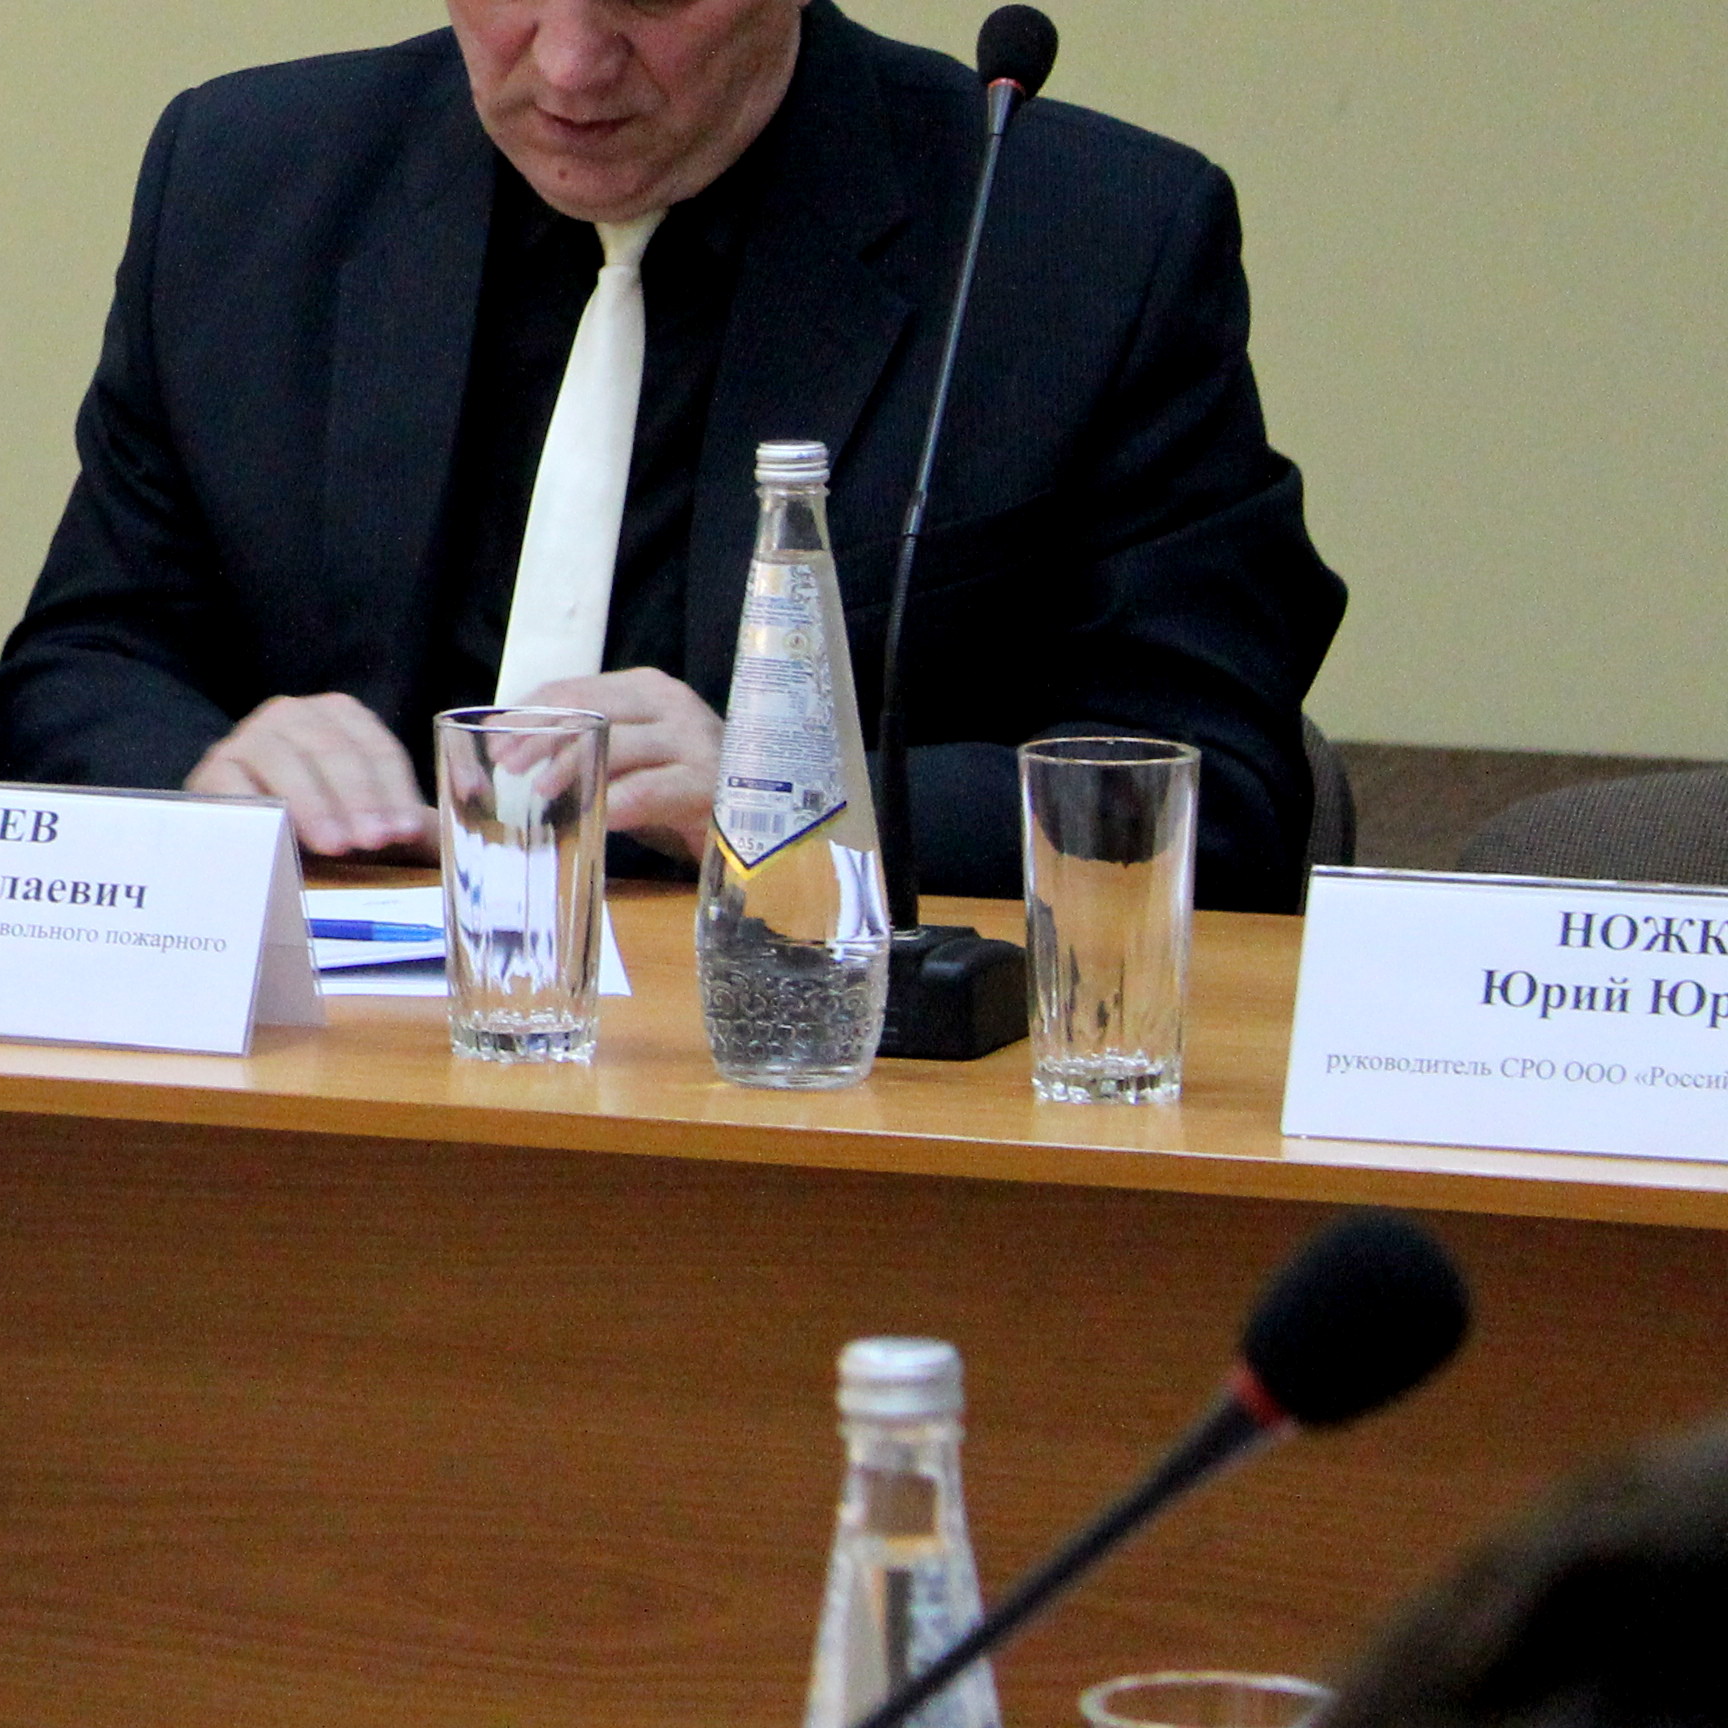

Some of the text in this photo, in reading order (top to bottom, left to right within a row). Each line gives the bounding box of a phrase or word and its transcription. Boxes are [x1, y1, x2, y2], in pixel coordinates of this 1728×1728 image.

[106, 930, 227, 953] пожарного
[1556, 911, 1728, 956] НОЖК
[1479, 969, 1632, 1020] Юрий
[1326, 1054, 1492, 1076] руководитель
[1500, 1057, 1556, 1080] СРО
[1563, 1061, 1627, 1084] ООО
